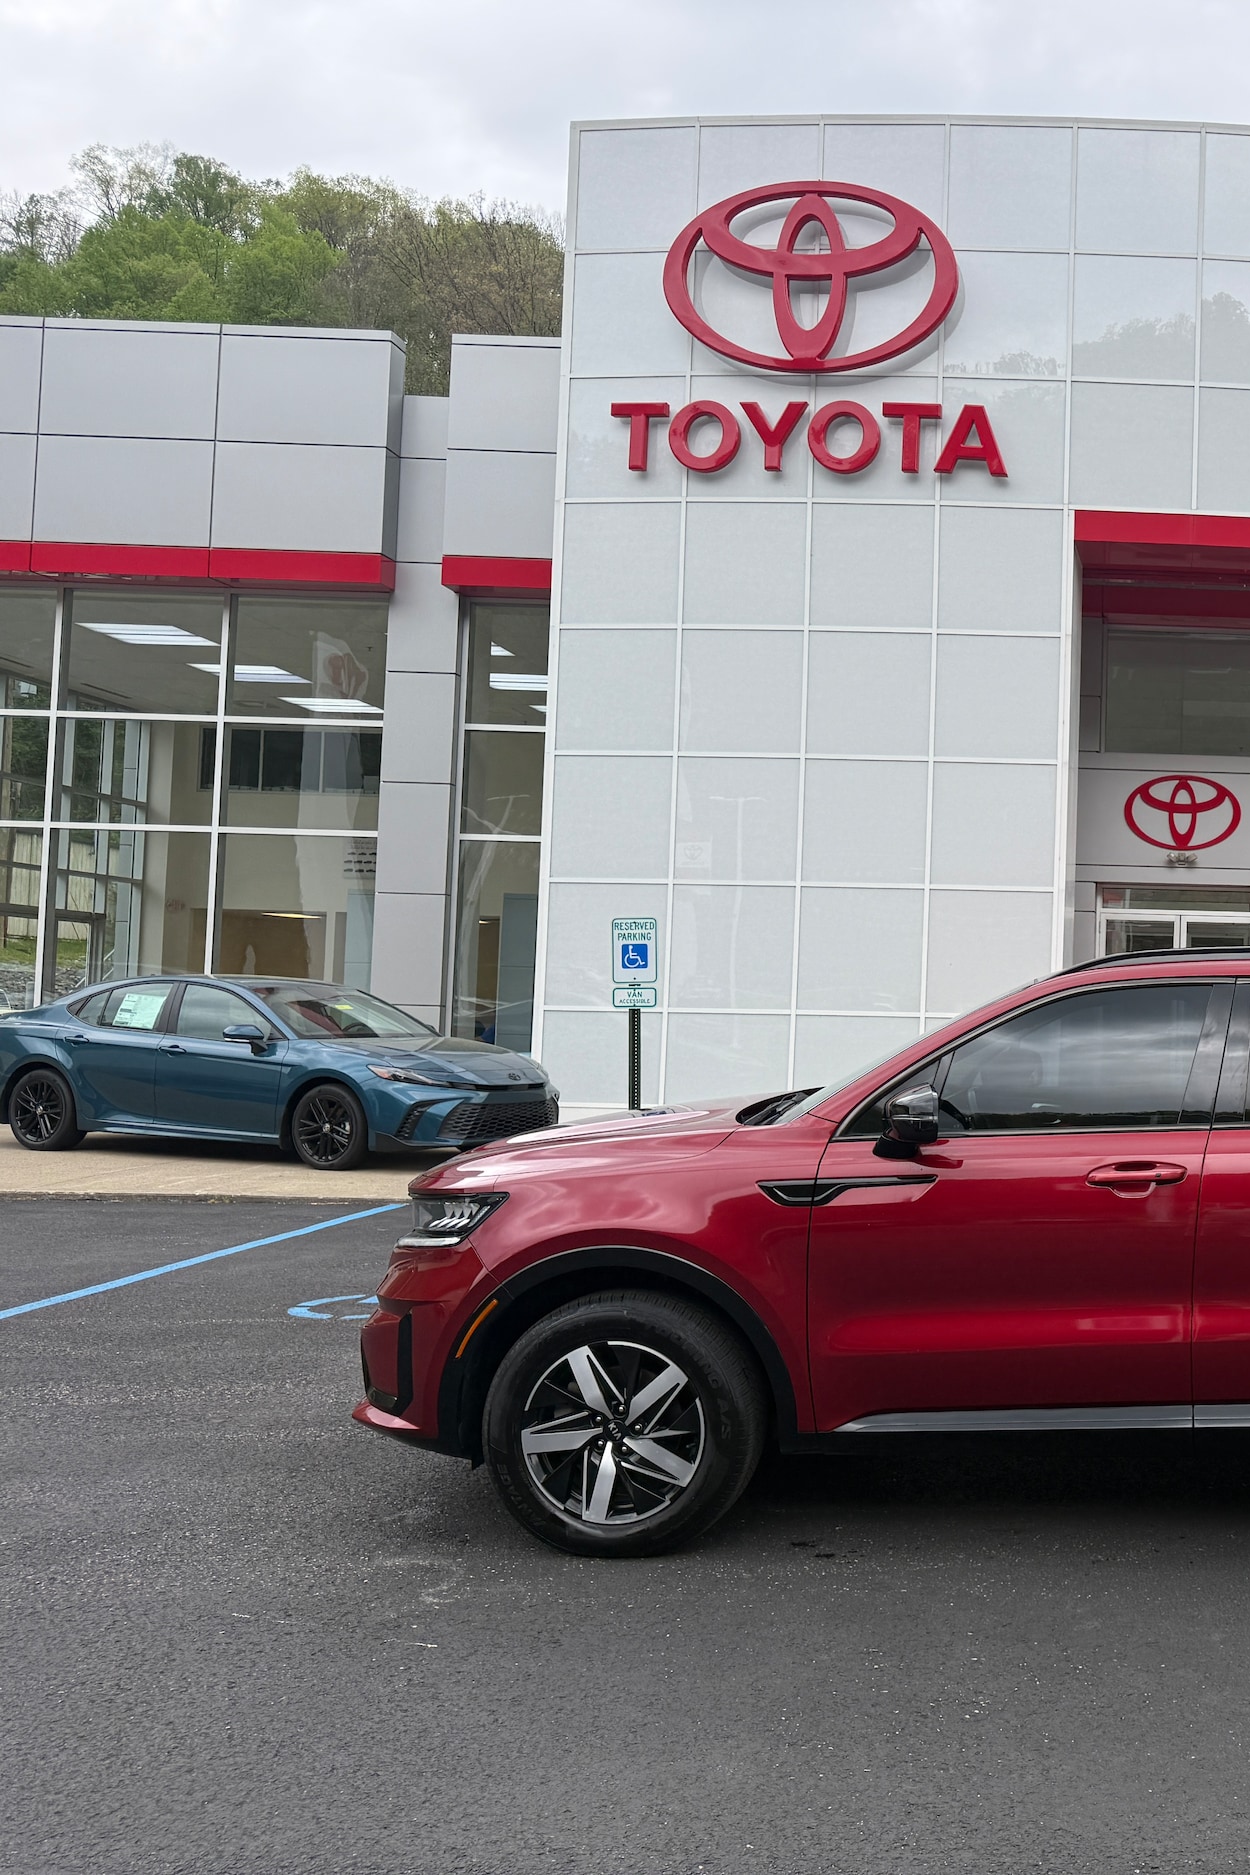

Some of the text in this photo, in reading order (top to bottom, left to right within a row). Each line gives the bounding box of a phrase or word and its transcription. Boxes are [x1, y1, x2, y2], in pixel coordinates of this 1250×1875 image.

[610, 399, 1008, 478] TOYOTA
[614, 921, 655, 931] RESERVED
[617, 932, 652, 941] PARKING
[608, 1422, 622, 1440] KIA
